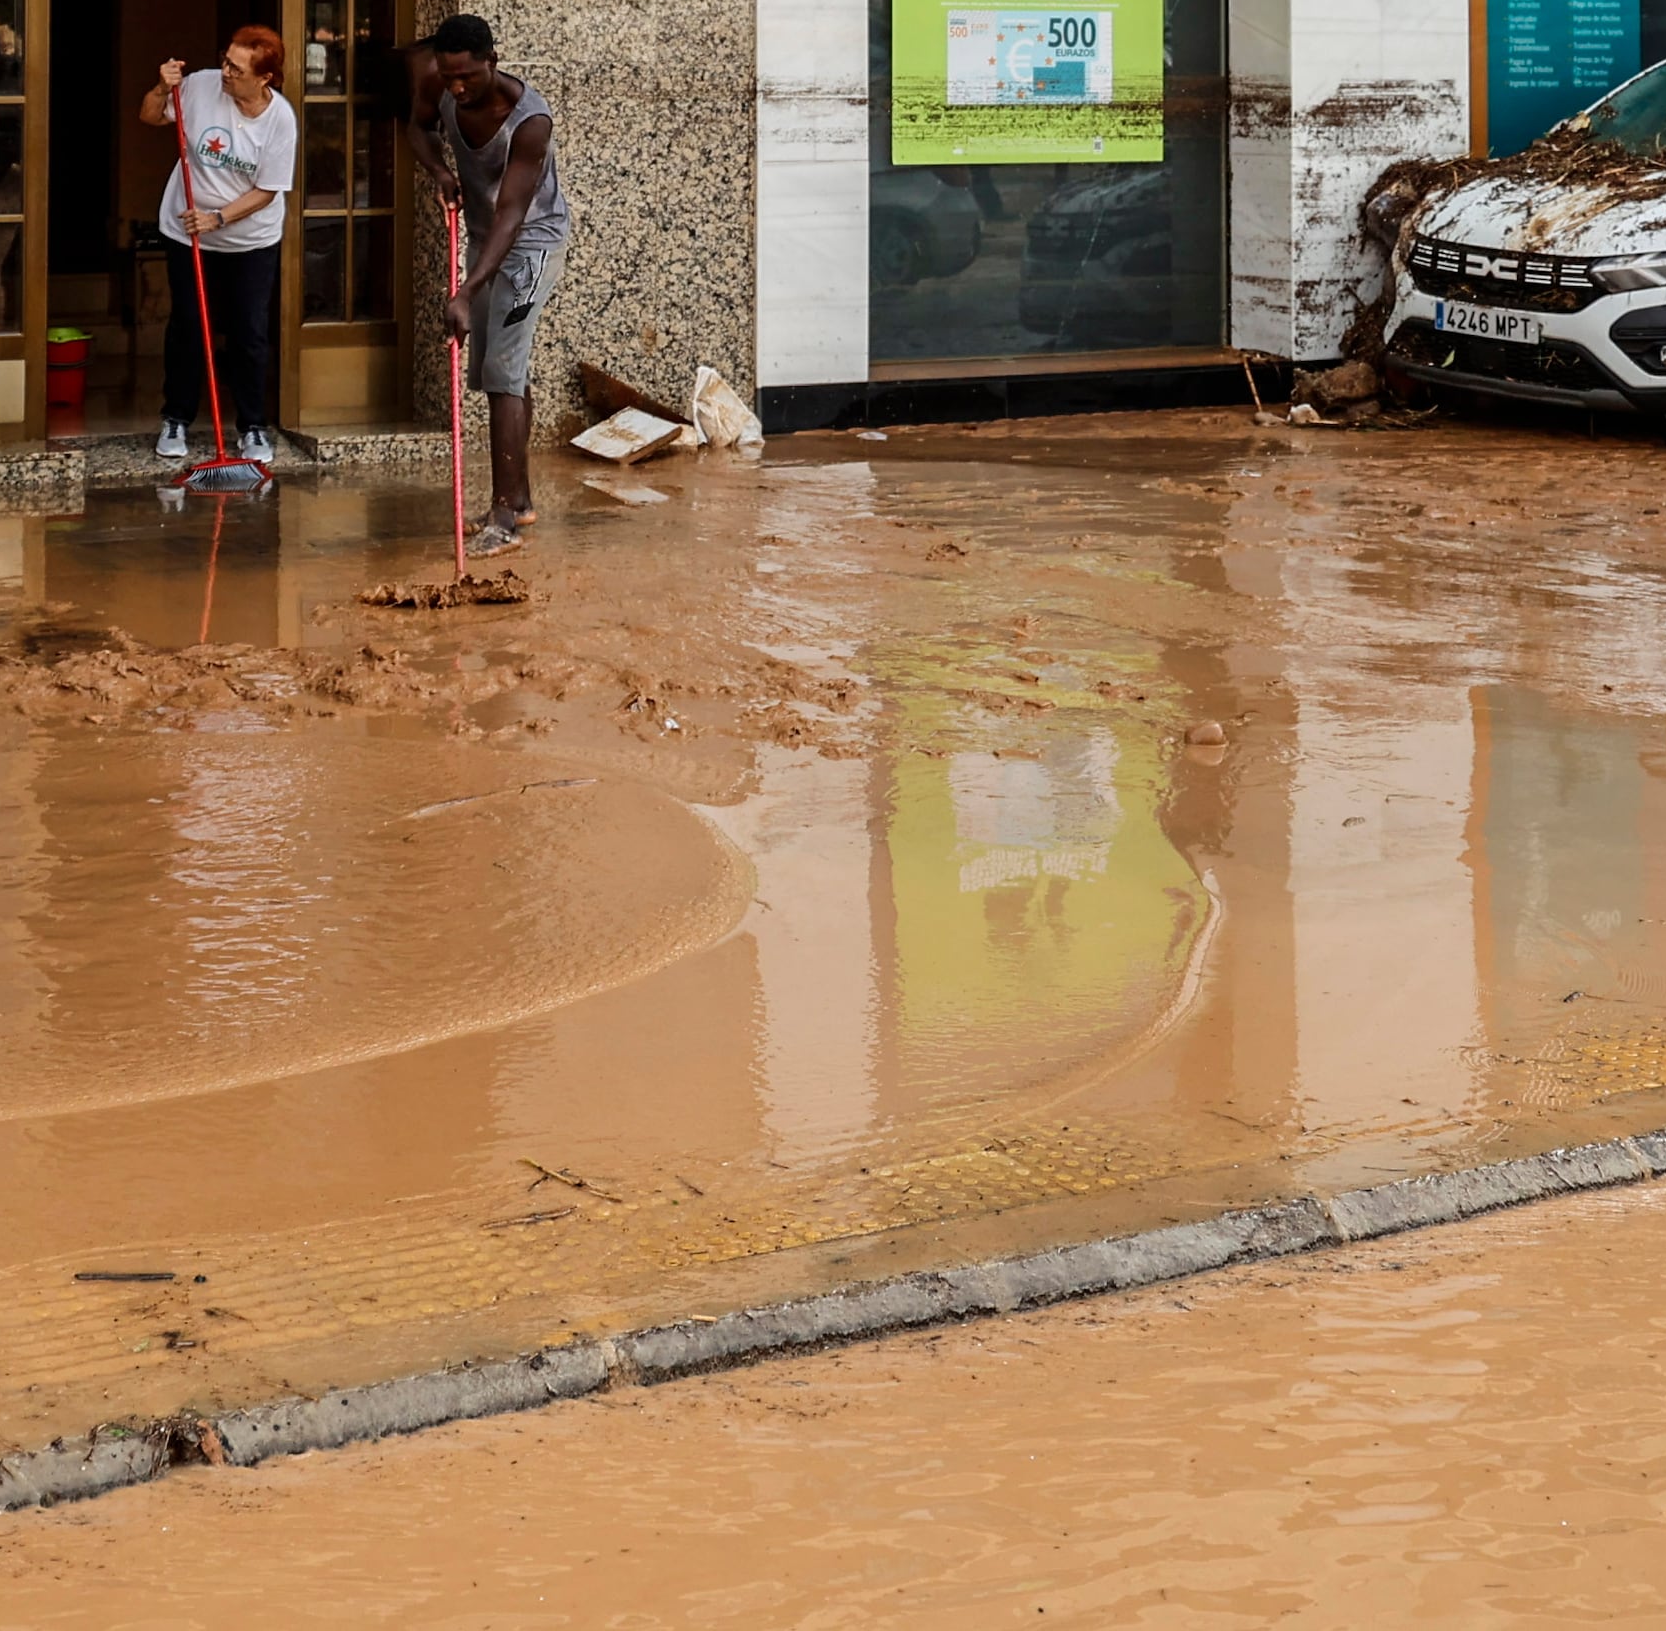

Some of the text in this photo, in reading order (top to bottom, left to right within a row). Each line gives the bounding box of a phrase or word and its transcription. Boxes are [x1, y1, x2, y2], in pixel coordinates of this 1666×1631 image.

[949, 26, 969, 38] 500
[1048, 17, 1097, 48] 500
[1055, 48, 1096, 58] EURAZOS
[199, 144, 258, 172] Heineken
[1446, 306, 1531, 340] 4246 MPT
